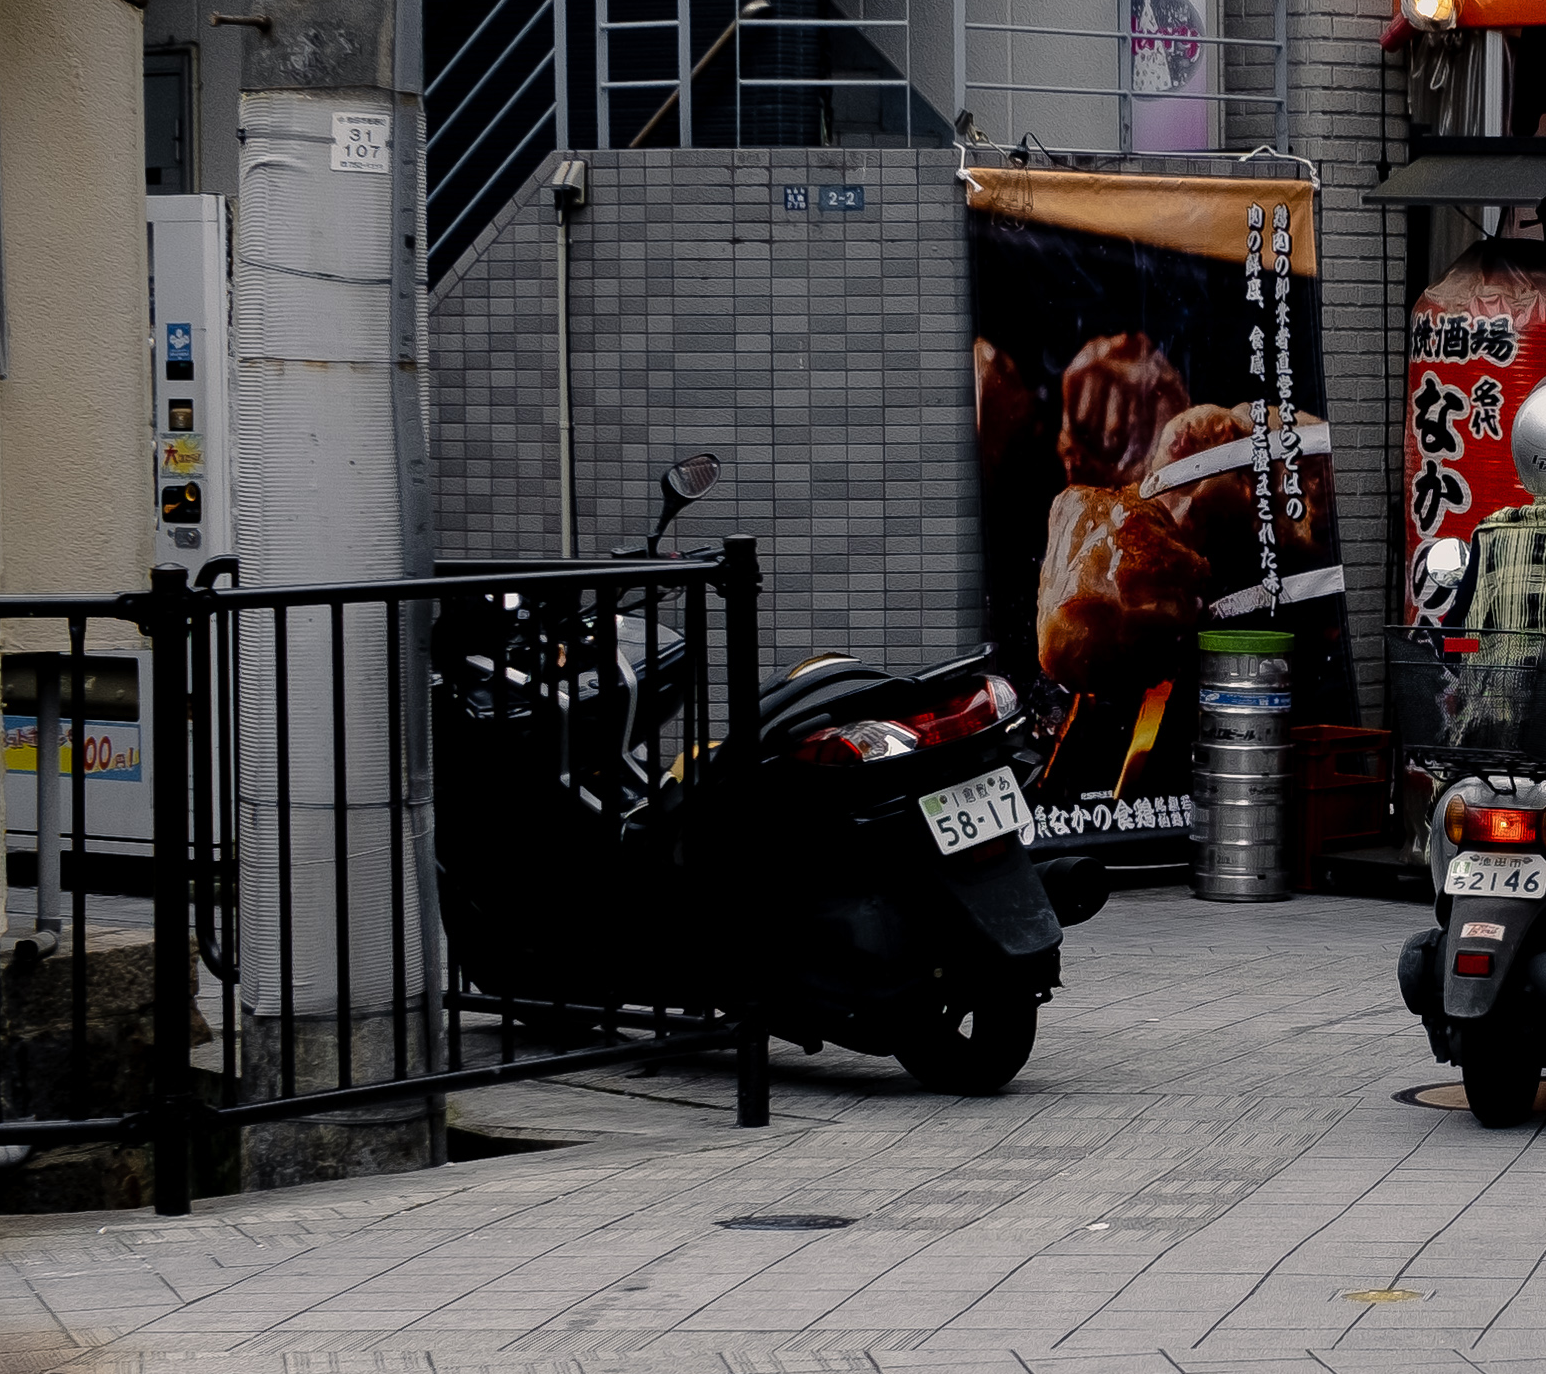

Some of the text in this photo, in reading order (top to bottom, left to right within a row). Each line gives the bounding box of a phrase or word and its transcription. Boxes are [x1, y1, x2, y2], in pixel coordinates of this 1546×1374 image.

[349, 128, 372, 142] 31
[343, 144, 381, 158] 107
[828, 191, 856, 206] 2-2
[1411, 373, 1472, 627] なかの
[936, 792, 1018, 847] 58-17
[1479, 856, 1522, 868] 池田市
[1468, 868, 1541, 894] 2146
